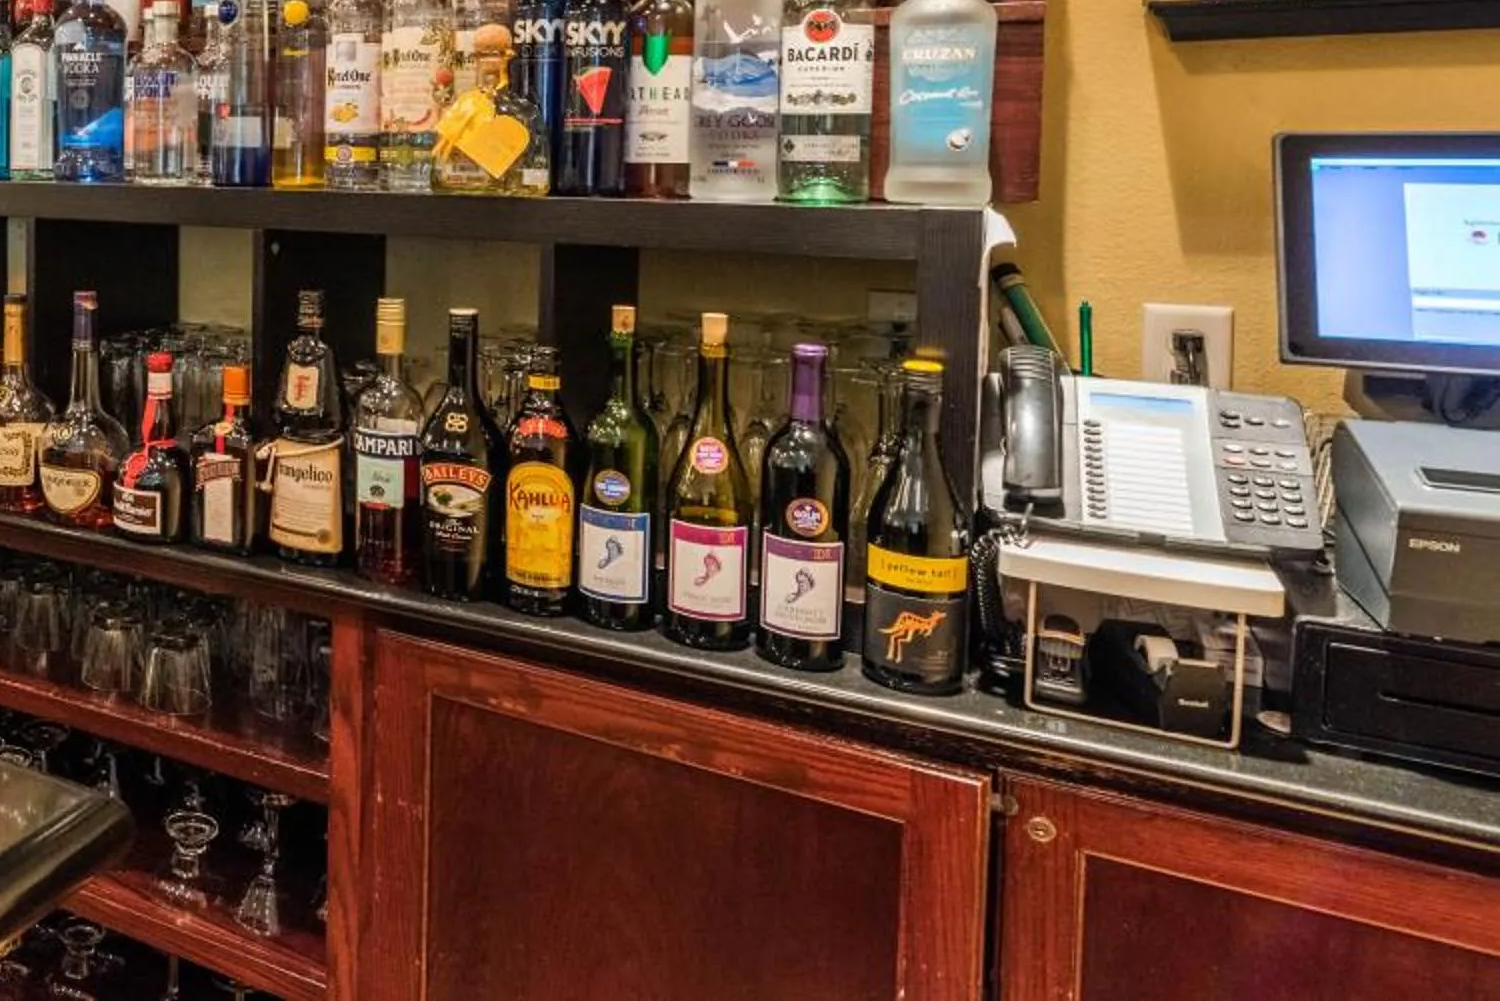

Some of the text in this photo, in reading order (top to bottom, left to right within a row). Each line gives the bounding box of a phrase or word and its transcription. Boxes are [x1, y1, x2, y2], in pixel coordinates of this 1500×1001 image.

[566, 21, 627, 46] SKYY
[901, 46, 977, 61] CRUZAN
[279, 462, 333, 482] rangelico
[425, 466, 487, 487] BAILEYS
[1407, 537, 1461, 554] EPSON
